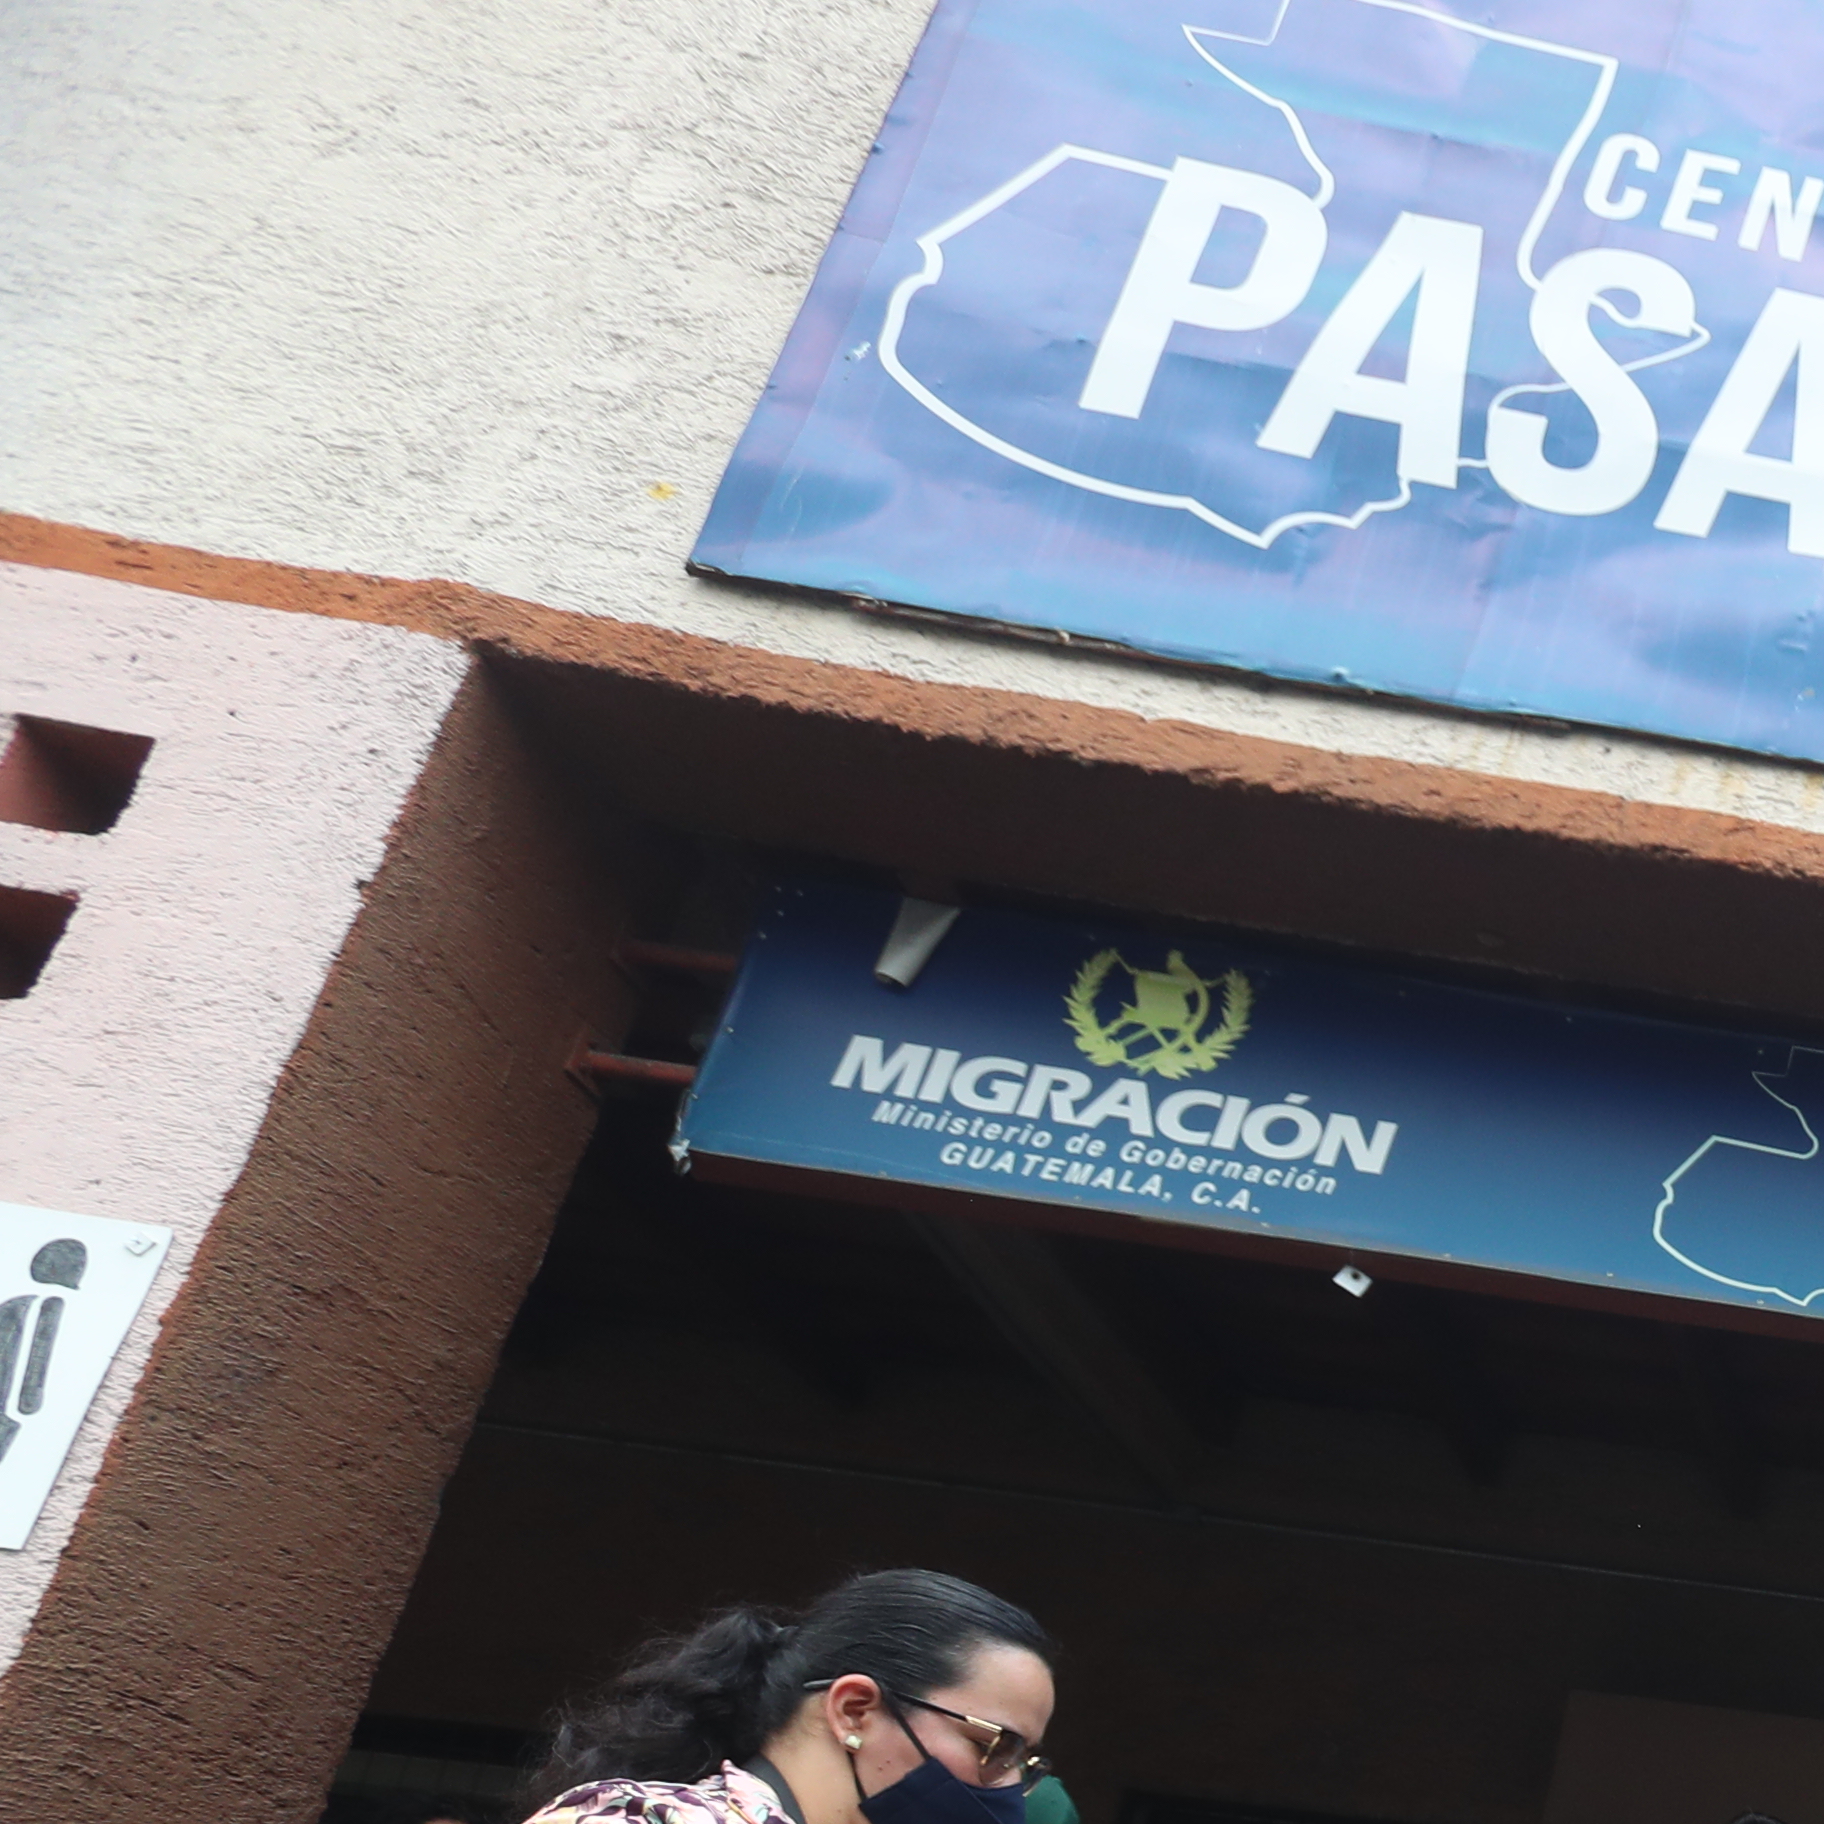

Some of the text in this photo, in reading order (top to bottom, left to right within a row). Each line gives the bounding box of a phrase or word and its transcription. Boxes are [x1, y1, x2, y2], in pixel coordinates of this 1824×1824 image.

[830, 1034, 1400, 1176] MIGRACIÓN
[871, 1100, 1338, 1197] Ministerio de Gobernación
[939, 1140, 1263, 1216] GUATEMALA, C.A.
